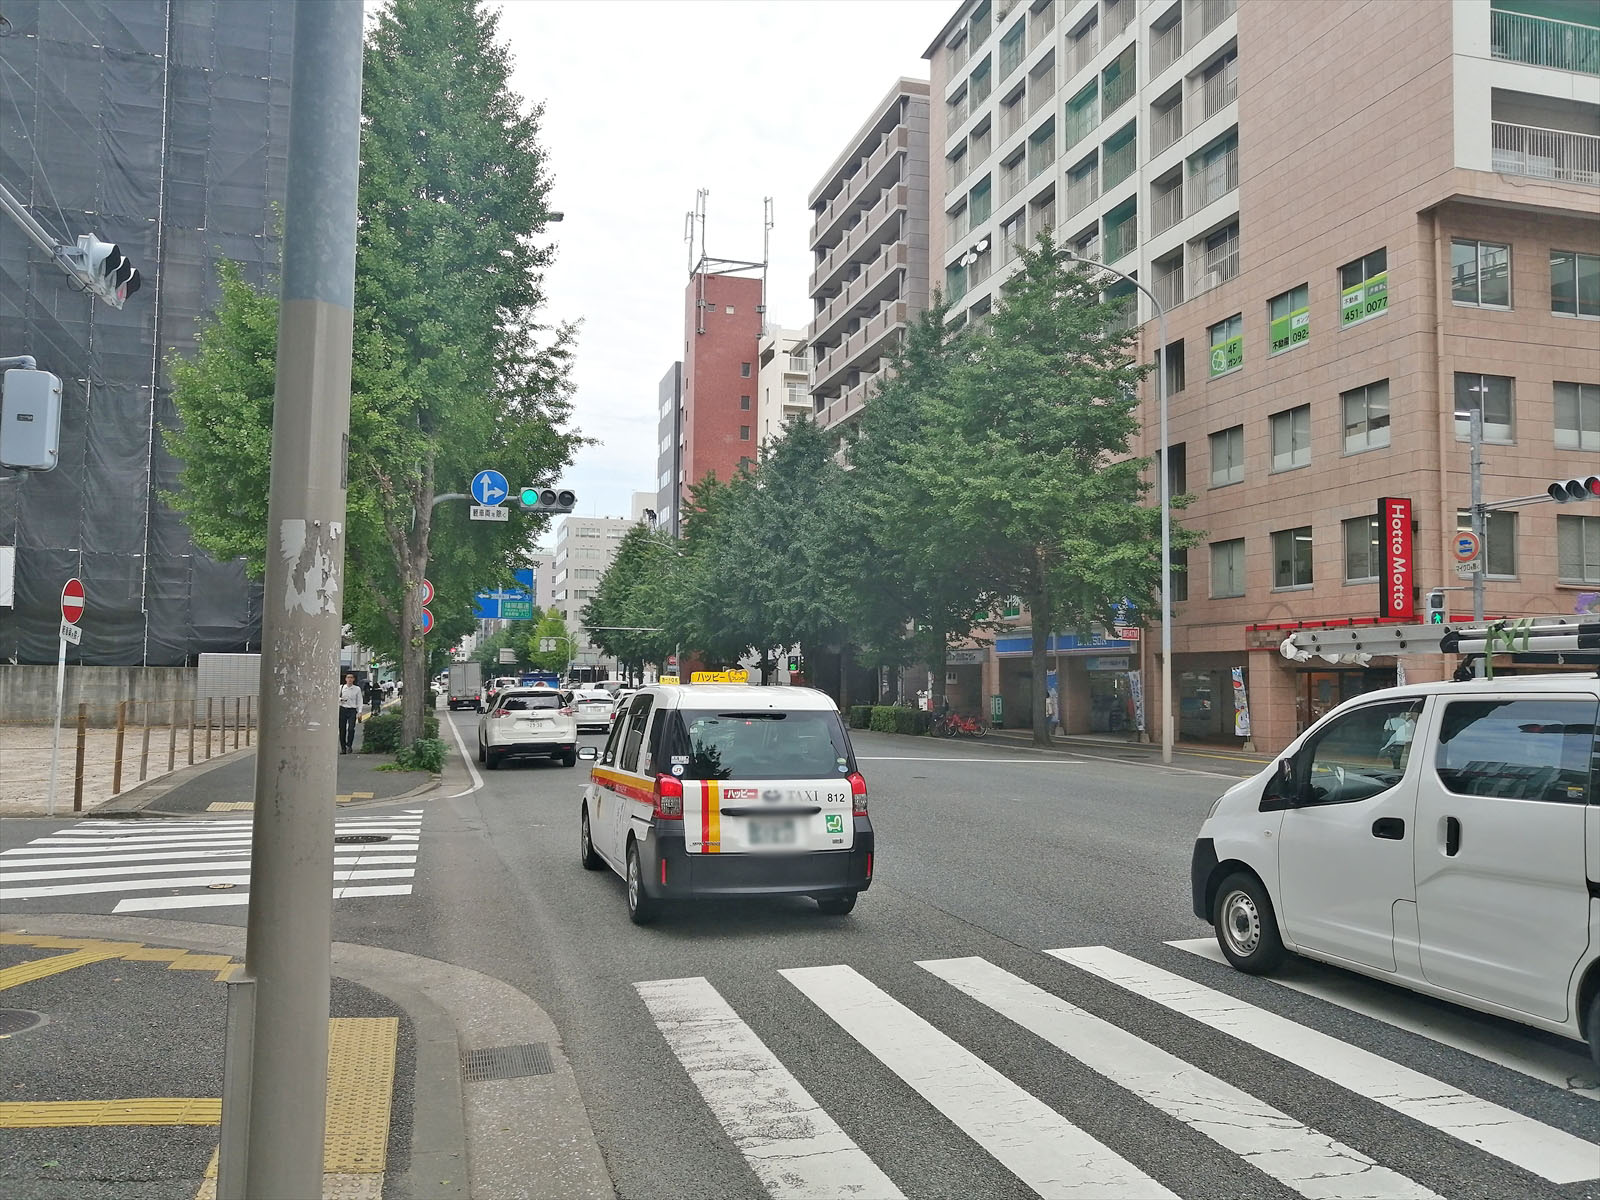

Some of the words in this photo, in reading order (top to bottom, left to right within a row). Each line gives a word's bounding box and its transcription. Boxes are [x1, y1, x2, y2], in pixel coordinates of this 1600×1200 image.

[1345, 309, 1363, 321] 451-
[1366, 296, 1388, 313] 0077
[1293, 329, 1309, 342] 092-
[1228, 342, 1237, 354] 4F
[1272, 336, 1289, 350] 不動産
[1391, 504, 1405, 555] Hotto
[1393, 557, 1407, 610] Motto
[697, 673, 725, 682] ハッピー
[727, 789, 756, 799] ハッピー
[788, 790, 818, 801] TAXI
[827, 793, 845, 802] 812
